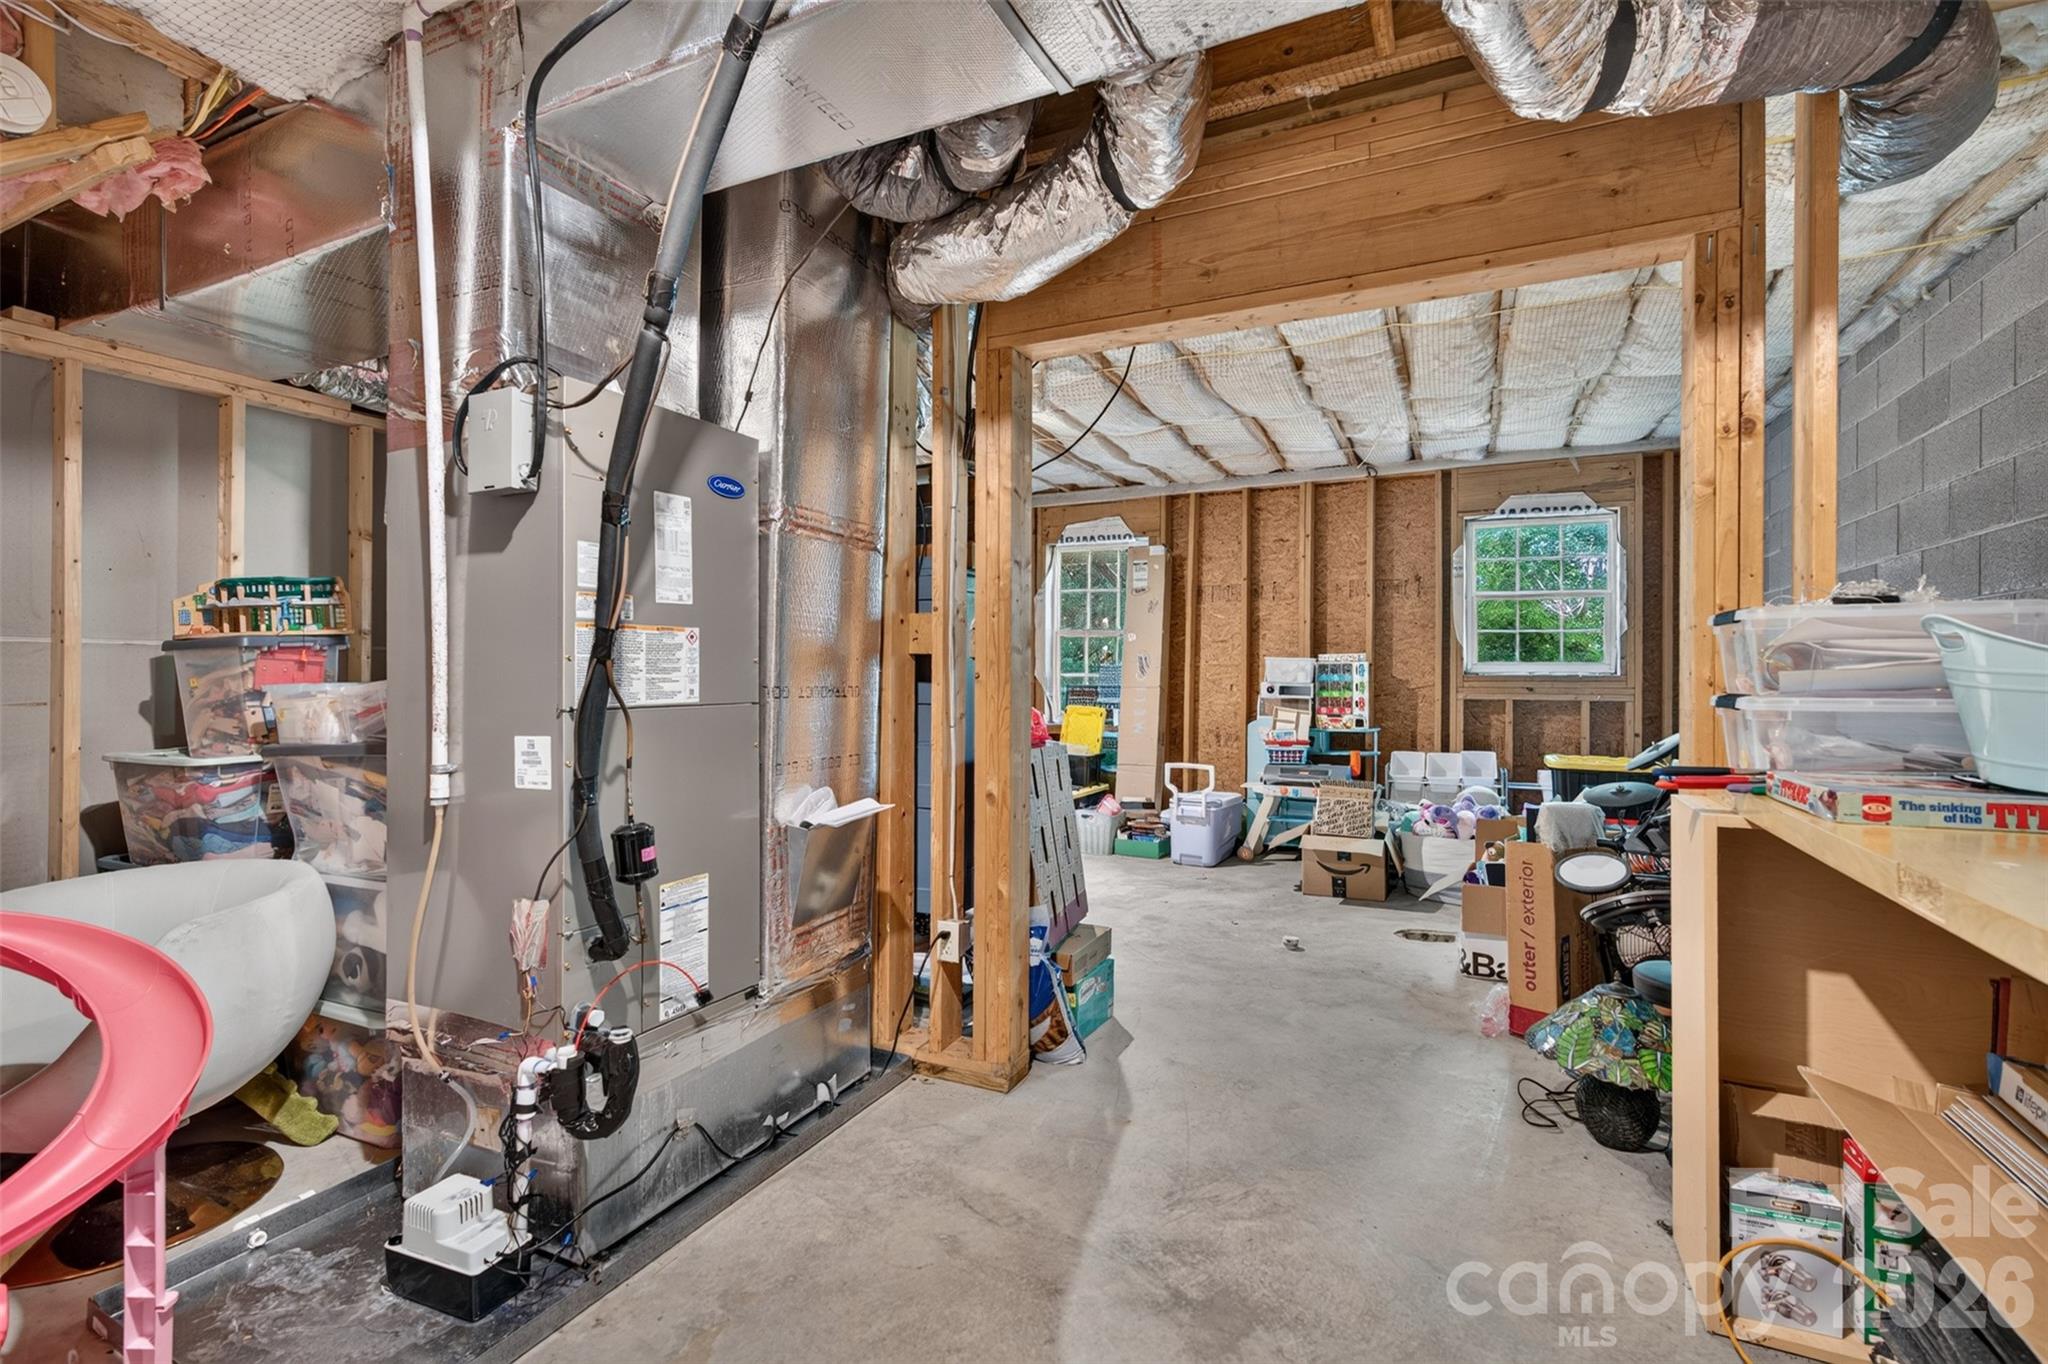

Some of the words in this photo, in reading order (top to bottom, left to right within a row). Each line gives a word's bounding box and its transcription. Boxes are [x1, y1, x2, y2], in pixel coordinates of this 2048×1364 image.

[1899, 799, 1925, 812] The
[1929, 802, 1982, 816] sinking
[1944, 813, 1957, 824] of
[1960, 813, 1983, 825] the
[1518, 860, 1536, 926] exterior
[1523, 941, 1537, 993] outer
